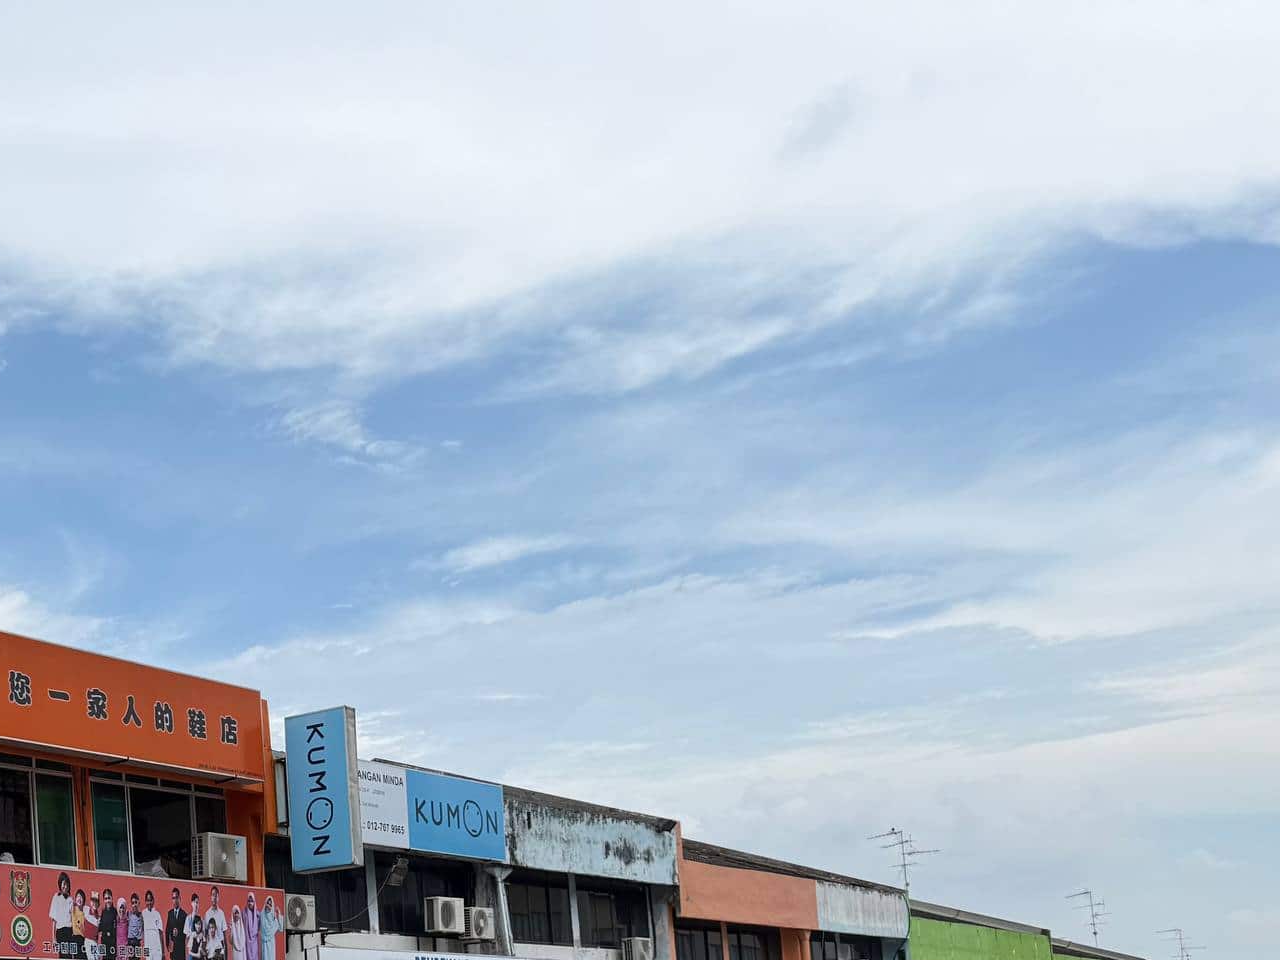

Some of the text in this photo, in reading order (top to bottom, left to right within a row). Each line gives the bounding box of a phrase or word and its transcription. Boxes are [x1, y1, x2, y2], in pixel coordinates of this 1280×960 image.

[8, 669, 238, 745] 您一家人的鞋店
[306, 722, 334, 856] KUMON
[382, 774, 404, 786] MINDA
[414, 797, 498, 838] KUMON
